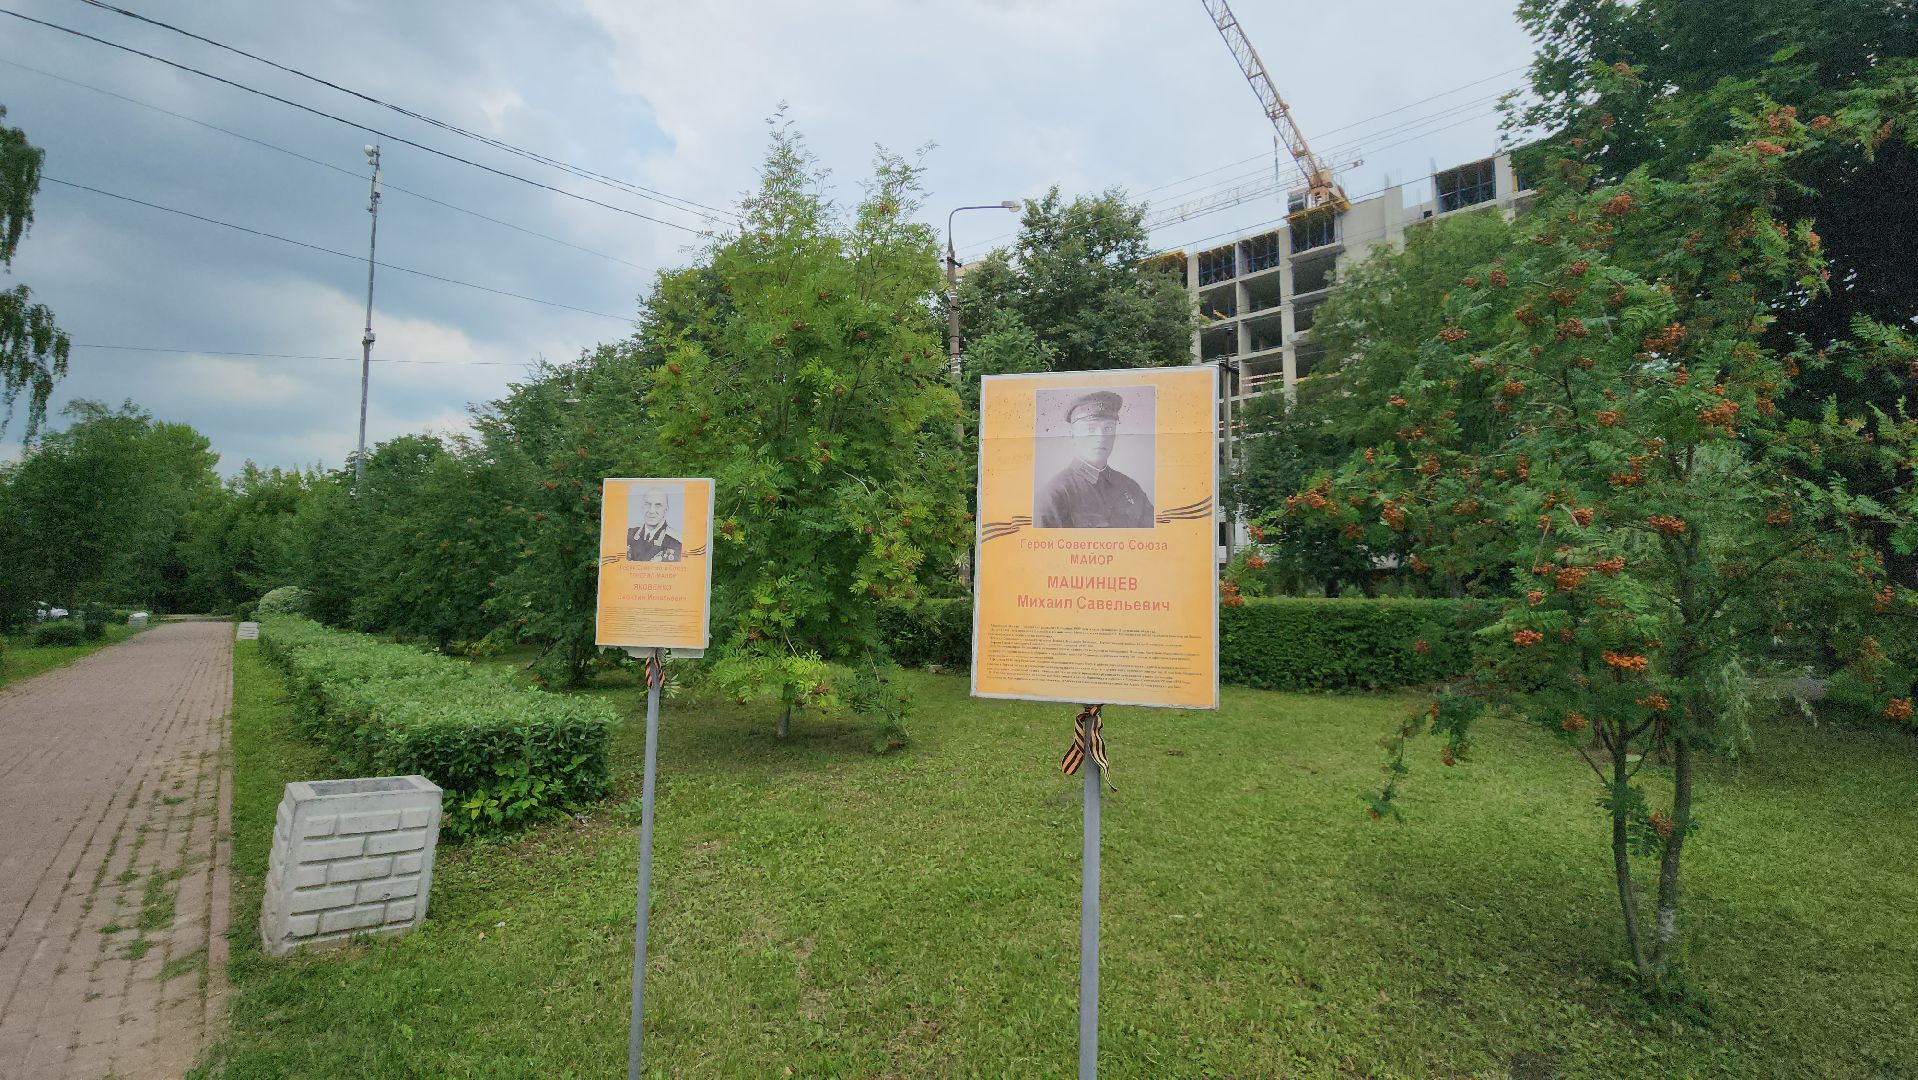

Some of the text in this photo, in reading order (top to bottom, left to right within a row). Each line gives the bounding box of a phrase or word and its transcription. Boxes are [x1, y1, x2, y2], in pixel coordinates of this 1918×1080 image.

[1057, 538, 1125, 550] Советского
[1128, 539, 1169, 551] Союза
[1070, 552, 1114, 565] МАЙОР
[1047, 575, 1138, 592] МАШИНЦЕВ
[1017, 594, 1170, 611] Михаил Савельевич
